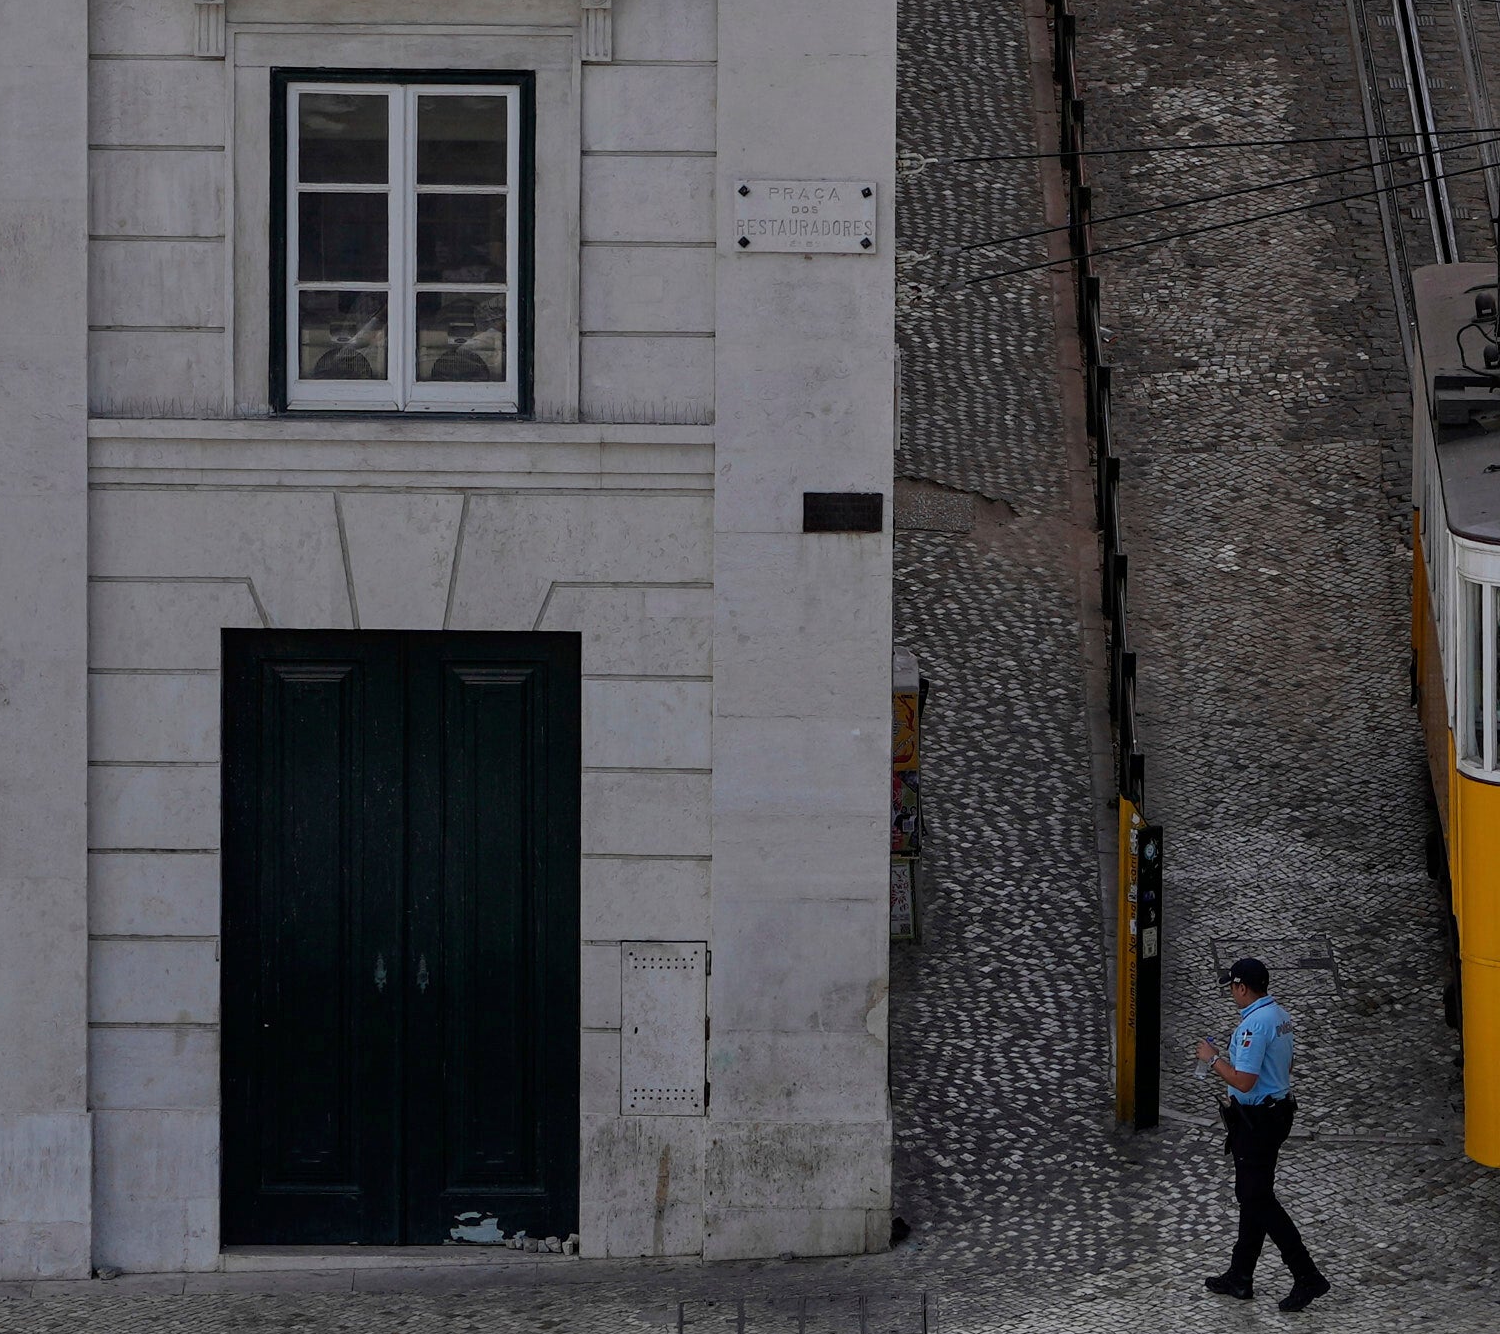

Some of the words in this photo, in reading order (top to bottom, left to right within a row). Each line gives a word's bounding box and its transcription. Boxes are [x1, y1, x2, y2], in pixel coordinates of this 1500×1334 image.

[769, 187, 840, 208] PRAÇA
[791, 206, 818, 218] DOS
[736, 218, 873, 237] RESTAURADORES
